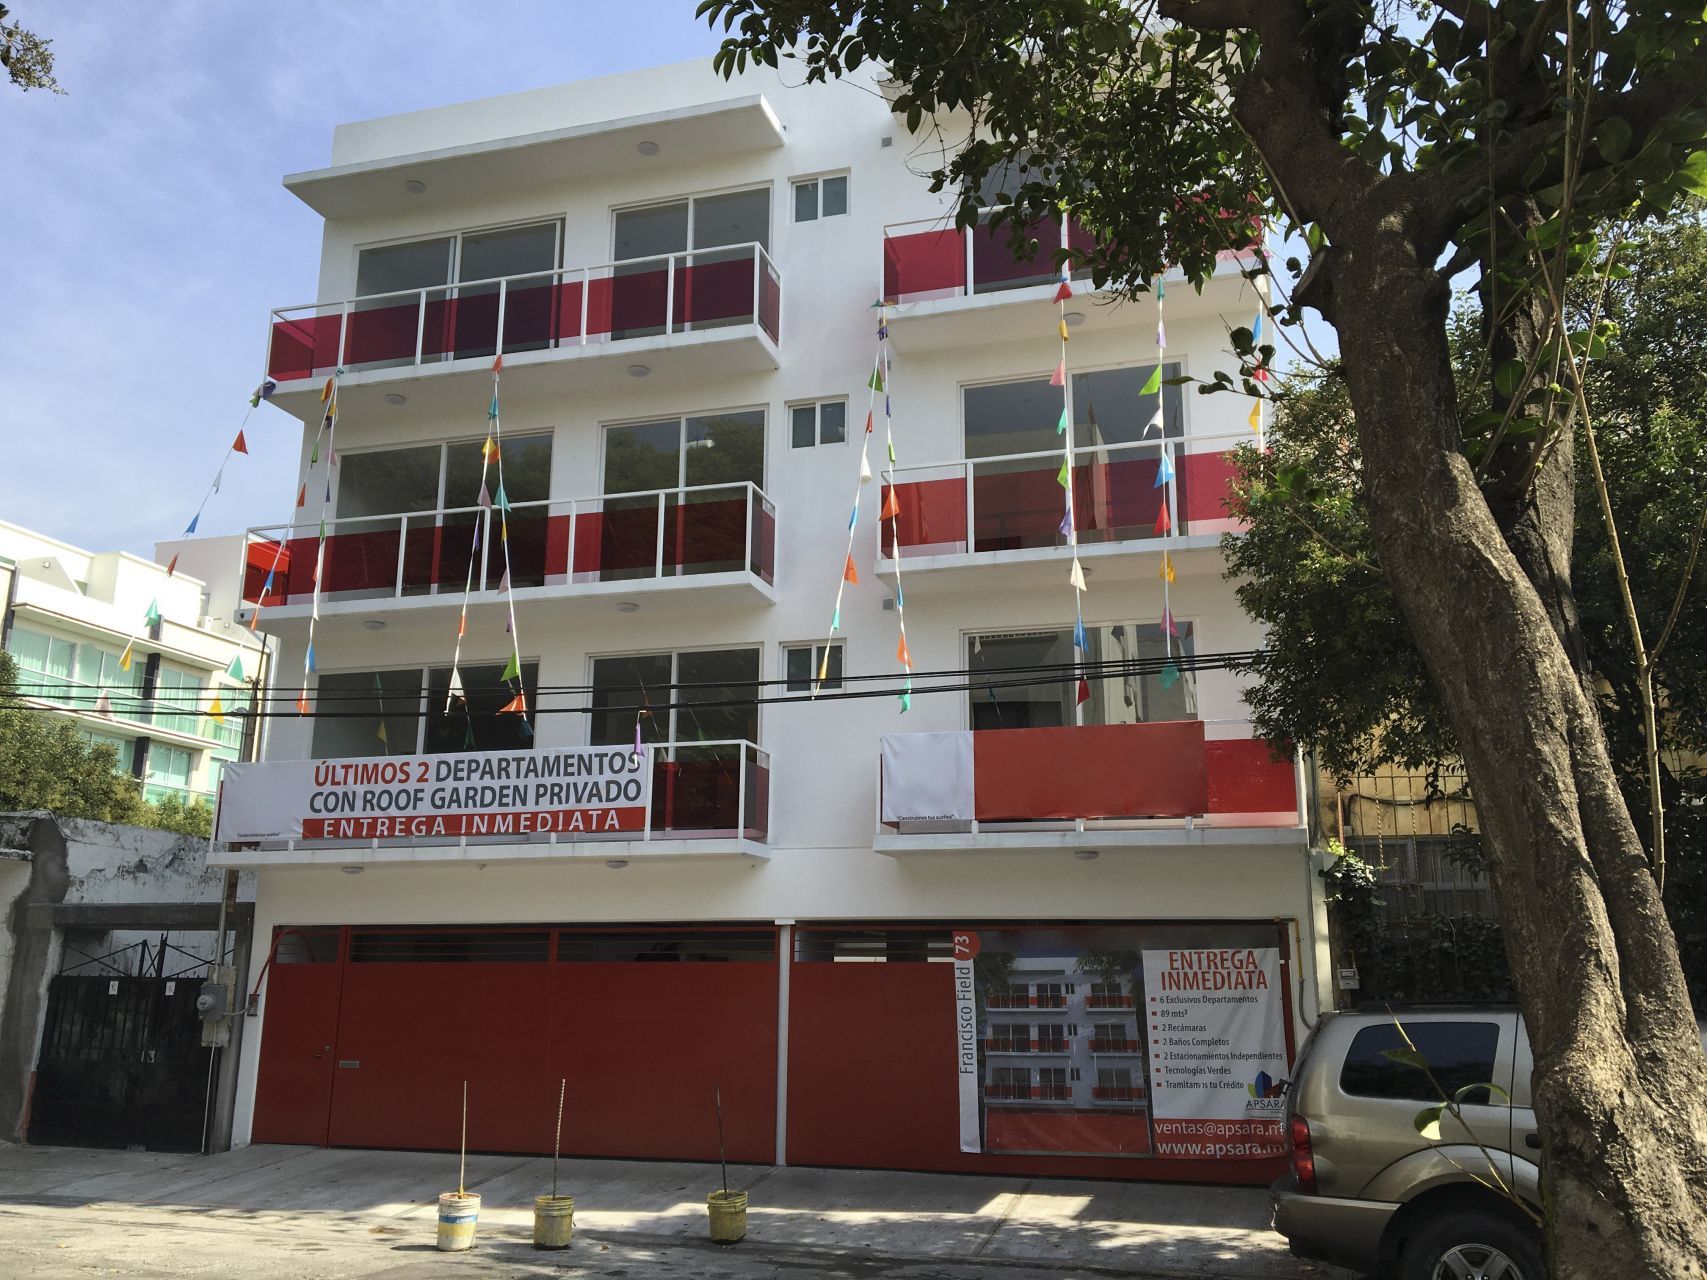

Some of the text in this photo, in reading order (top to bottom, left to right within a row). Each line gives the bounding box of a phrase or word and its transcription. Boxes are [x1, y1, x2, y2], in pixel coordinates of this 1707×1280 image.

[315, 752, 640, 786] ÚLTIMOS 2 DEPARTAMENTOS
[310, 779, 641, 813] CON ROOF GARDEN PRIVADO
[323, 810, 619, 838] ENTREGA INMEDIATA
[1169, 950, 1258, 971] ENTREGA
[1160, 970, 1268, 991] INMEDIATA
[955, 935, 973, 1074] Francisco Field 73
[1160, 995, 1258, 1005] 6 Exclusivos Departamentos
[1168, 1023, 1207, 1032] Recámaras
[1163, 1037, 1230, 1047] 2 Baños Completos
[1164, 1051, 1283, 1061] 2 Estacionamientos Independientes
[1165, 1066, 1232, 1076] Tecnologías Verdes
[1209, 1081, 1217, 1089] tu
[1218, 1080, 1244, 1089] Crédito
[1154, 1121, 1284, 1138] ventas@apsara.m
[1157, 1142, 1286, 1159] www.apsara.m
